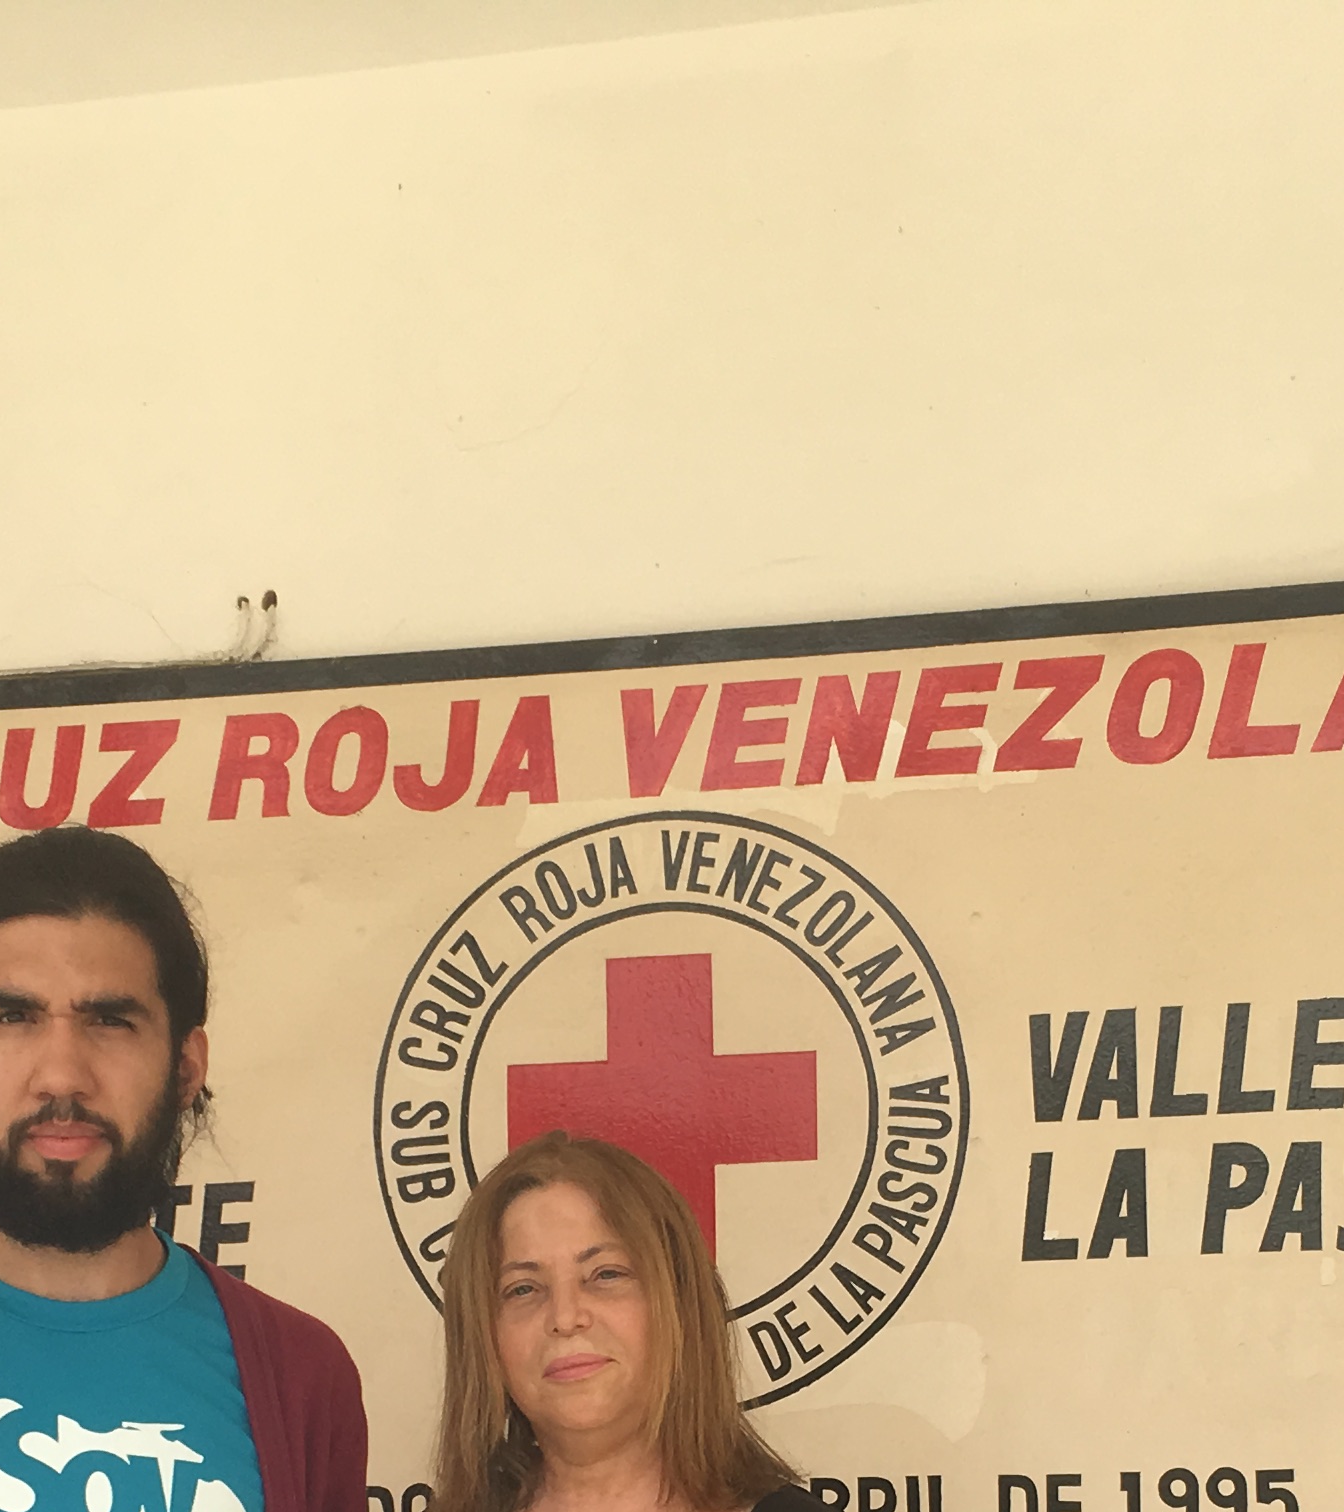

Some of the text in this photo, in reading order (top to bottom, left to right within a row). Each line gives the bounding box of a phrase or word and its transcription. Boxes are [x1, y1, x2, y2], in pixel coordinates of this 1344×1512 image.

[207, 693, 559, 820] ROJA
[397, 829, 937, 1072] CRUZ ROJA VENEZOLANA
[390, 1100, 456, 1204] SUB
[1021, 1147, 1149, 1262] LA
[746, 1074, 953, 1383] DE LA PASCUA
